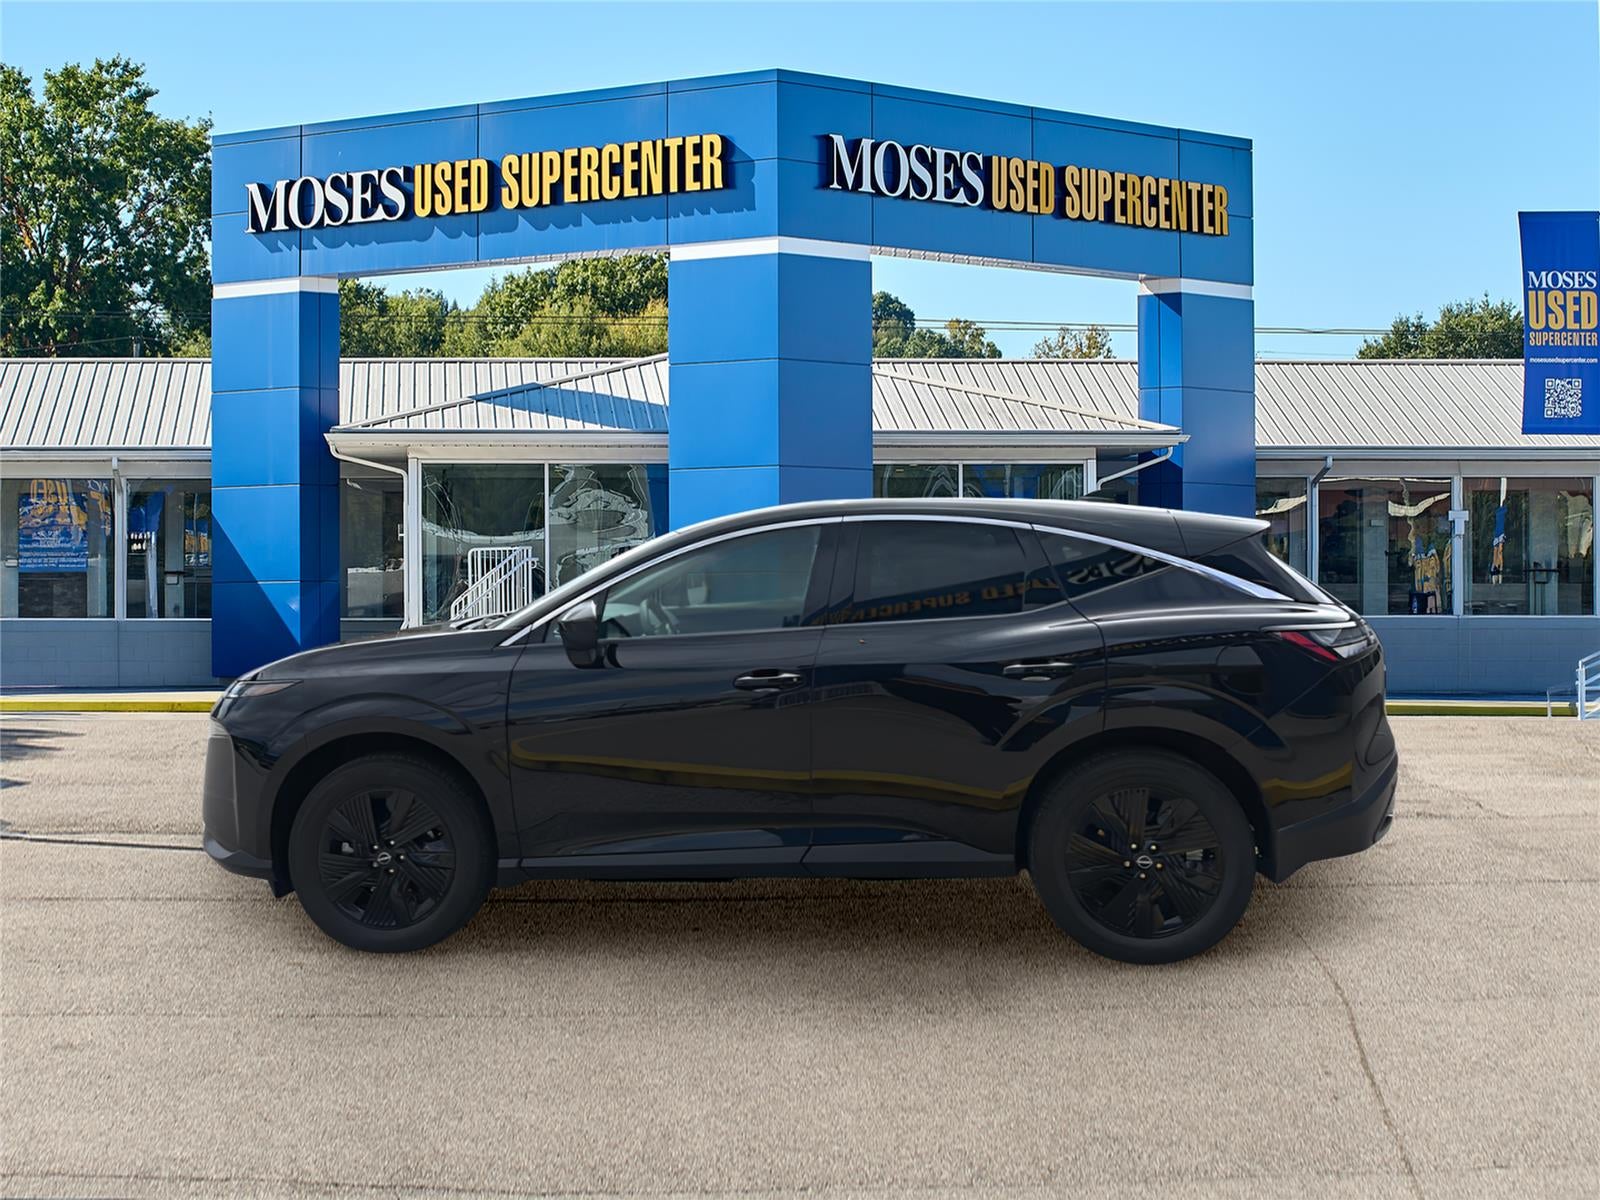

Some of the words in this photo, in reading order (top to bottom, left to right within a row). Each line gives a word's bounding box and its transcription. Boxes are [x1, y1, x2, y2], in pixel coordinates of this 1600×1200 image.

[245, 166, 407, 234] MOSES
[414, 158, 489, 218] USED
[501, 133, 723, 210] SUPERCENTER
[829, 133, 984, 207] MOSES
[991, 155, 1055, 215] USED
[1065, 165, 1229, 236] SUPERCENTER
[1528, 270, 1597, 289] MOSES
[1529, 290, 1598, 330] USED
[1529, 331, 1598, 347] SUPERCENTER
[1529, 356, 1598, 364] mosesusedsupercenter.com
